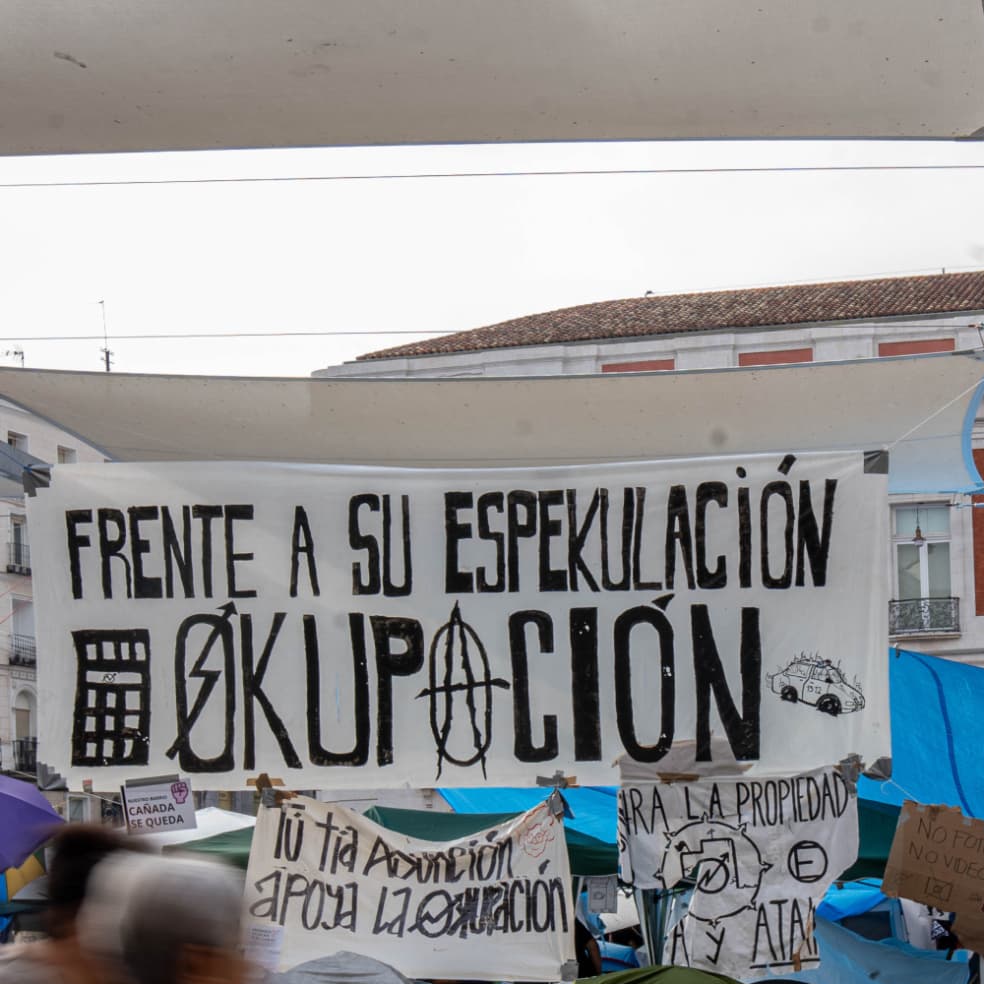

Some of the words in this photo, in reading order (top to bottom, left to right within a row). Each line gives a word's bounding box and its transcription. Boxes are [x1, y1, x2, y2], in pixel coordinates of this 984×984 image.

[65, 504, 257, 600] FRENTE
[290, 505, 320, 598] A
[348, 493, 413, 597] SU
[444, 454, 838, 594] ESPEKULACIÓN
[129, 802, 176, 816] CAÑADA
[684, 782, 724, 820] LA
[735, 771, 848, 828] PROPIEDAD
[131, 819, 143, 829] SE
[145, 814, 184, 829] QUEDA
[917, 817, 948, 844] NO
[908, 840, 939, 864] NO
[705, 926, 727, 965] Y
